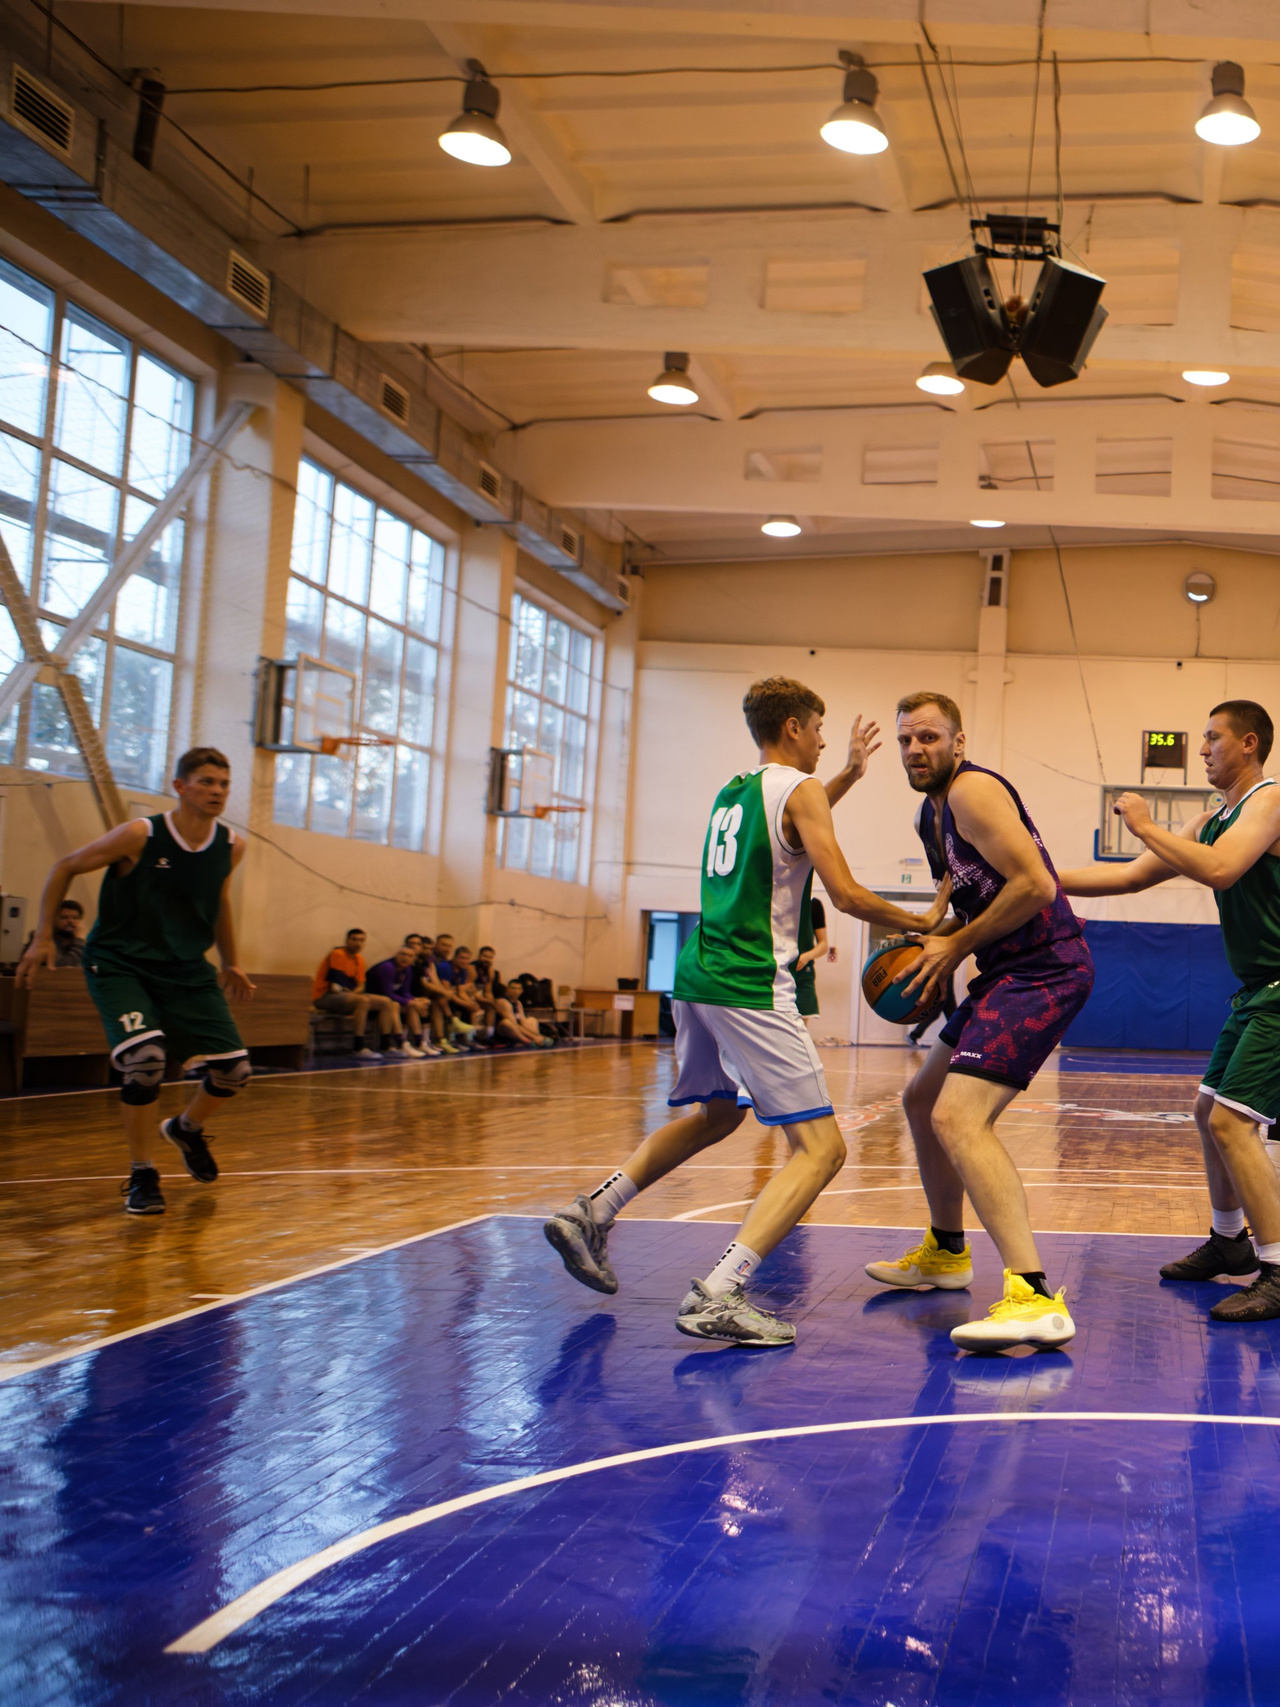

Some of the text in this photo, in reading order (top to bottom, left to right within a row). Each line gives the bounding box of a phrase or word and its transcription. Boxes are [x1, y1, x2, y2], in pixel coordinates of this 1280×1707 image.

[1149, 733, 1175, 746] 35.6
[706, 803, 744, 878] 13
[872, 969, 888, 987] FIBA
[118, 1011, 147, 1033] 12
[960, 1051, 982, 1059] MAXX
